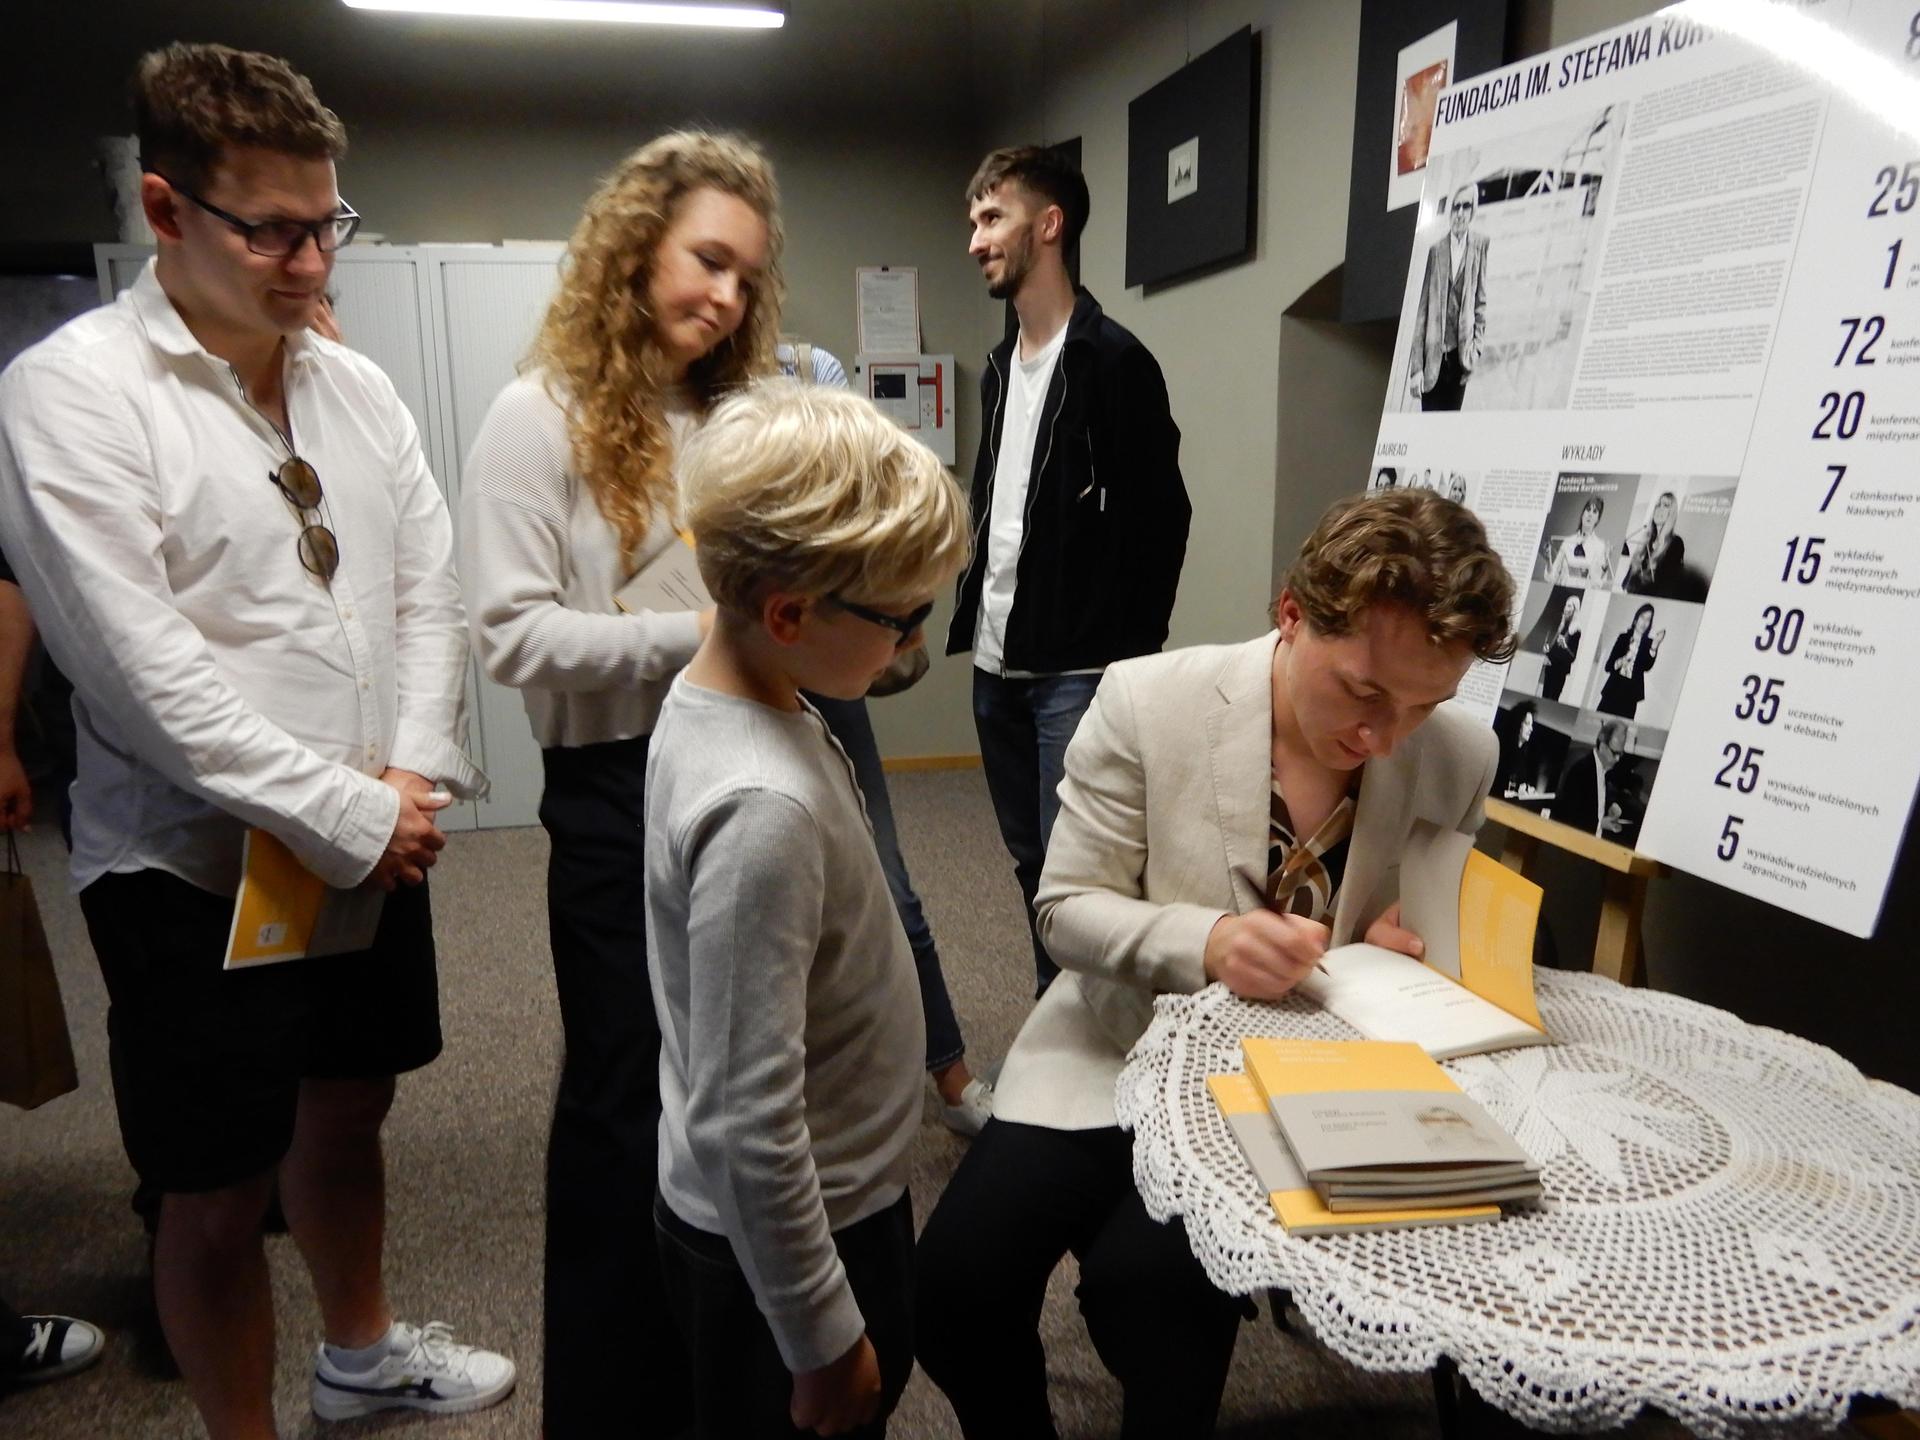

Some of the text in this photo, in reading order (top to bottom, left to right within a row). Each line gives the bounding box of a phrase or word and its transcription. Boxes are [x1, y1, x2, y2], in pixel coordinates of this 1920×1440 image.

[1435, 72, 1520, 127] FUNDACJA
[1525, 62, 1552, 99] IM.
[1558, 26, 1652, 88] STEFANA
[1867, 160, 1920, 219] 25
[1883, 238, 1903, 290] 1
[1833, 315, 1886, 368] 72
[1811, 390, 1866, 440] 20
[1819, 465, 1847, 513] 7
[1781, 536, 1826, 585] 15
[1754, 605, 1805, 655] 30
[1813, 622, 1863, 637] wykładów
[1804, 650, 1854, 668] krajowych
[1735, 674, 1785, 725] 35
[1787, 708, 1844, 727] uczestnictw
[1784, 723, 1838, 742] w debatach
[1713, 742, 1764, 794] 25
[1763, 791, 1811, 813] krajowych
[1767, 778, 1879, 816] wywiadów udzielonych
[1717, 814, 1744, 862] 5
[1742, 861, 1808, 891] zagranicznych
[1746, 847, 1856, 892] wywiadów udzielonych
